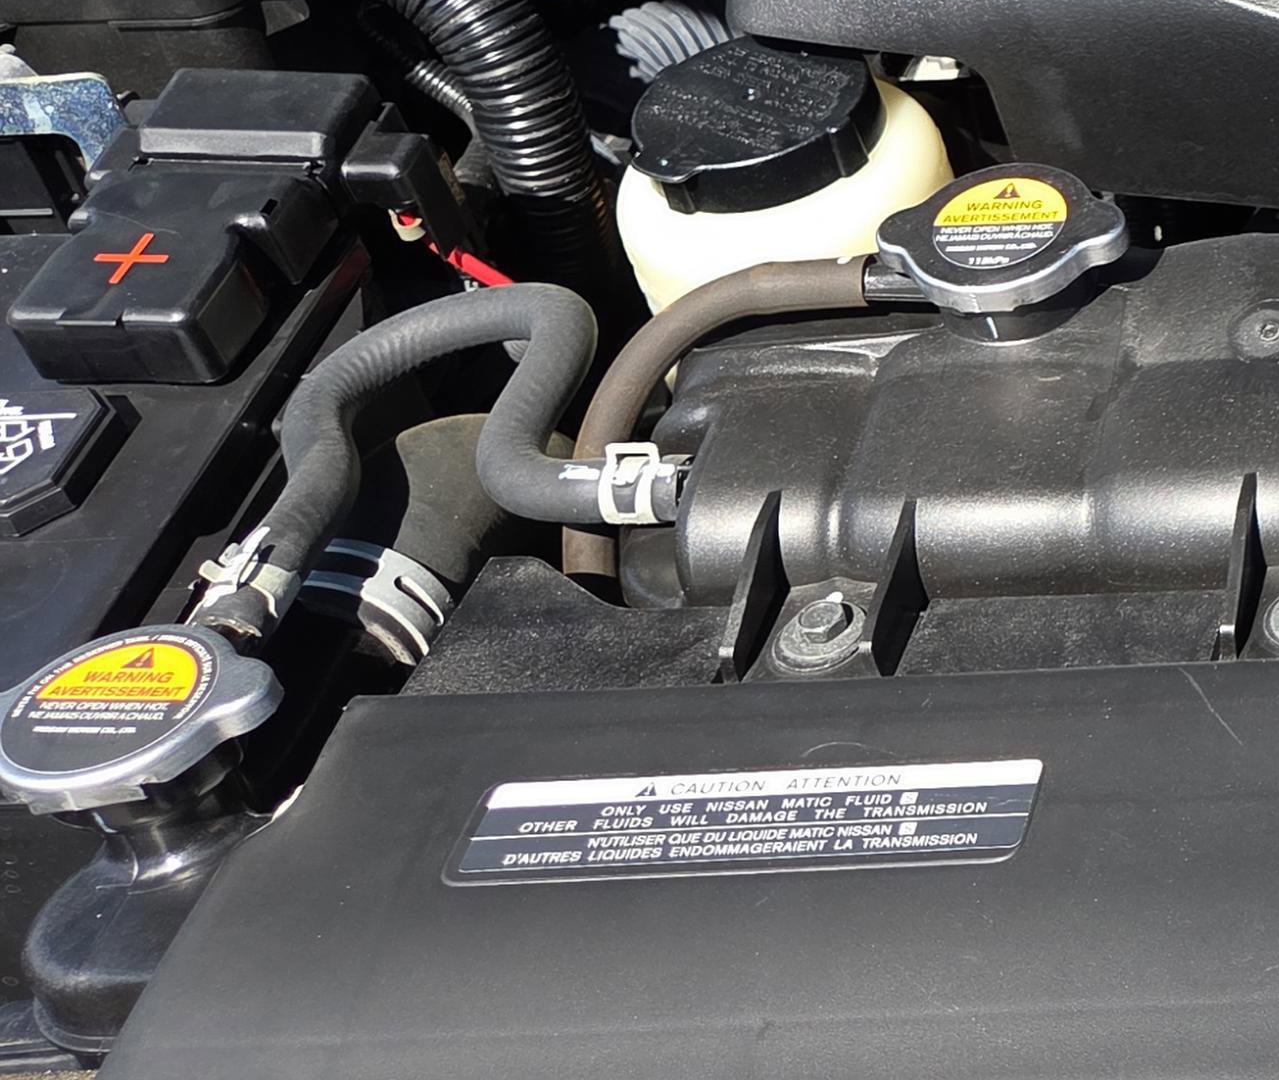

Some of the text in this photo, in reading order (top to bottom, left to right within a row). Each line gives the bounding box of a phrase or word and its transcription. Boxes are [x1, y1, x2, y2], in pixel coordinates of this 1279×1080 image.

[966, 199, 1043, 211] WARNING
[943, 211, 1058, 223] AVERTISSEMENT
[940, 226, 972, 234] NEVER
[972, 225, 1000, 233] OPEN
[1001, 224, 1031, 232] WHEN
[83, 671, 175, 684] WARNING
[50, 686, 187, 697] AVERTISSEMENT
[39, 701, 75, 710] NEVER
[76, 702, 109, 710] OPEN
[108, 702, 144, 711] WHEN
[670, 774, 902, 796] CAUTION ATTENTION
[600, 805, 647, 817] ONLY
[659, 803, 694, 814] USE
[705, 799, 769, 813] NISSAN
[781, 796, 833, 809] MATIC
[844, 793, 893, 806] FLUID
[518, 801, 988, 833] OTHER FLUIDS WILL DAMAGE THE TRANSMISSION
[587, 833, 666, 849] N'UTILISER
[668, 832, 702, 845] QUE
[702, 831, 727, 843] DU
[727, 828, 788, 842] LIQUIDE
[788, 826, 836, 839] MATIC
[836, 824, 893, 838] NISSAN
[502, 832, 978, 866] D'AUTRES LIQUIDES ENDOMMAGERAIENT LA TRANSMISSION
